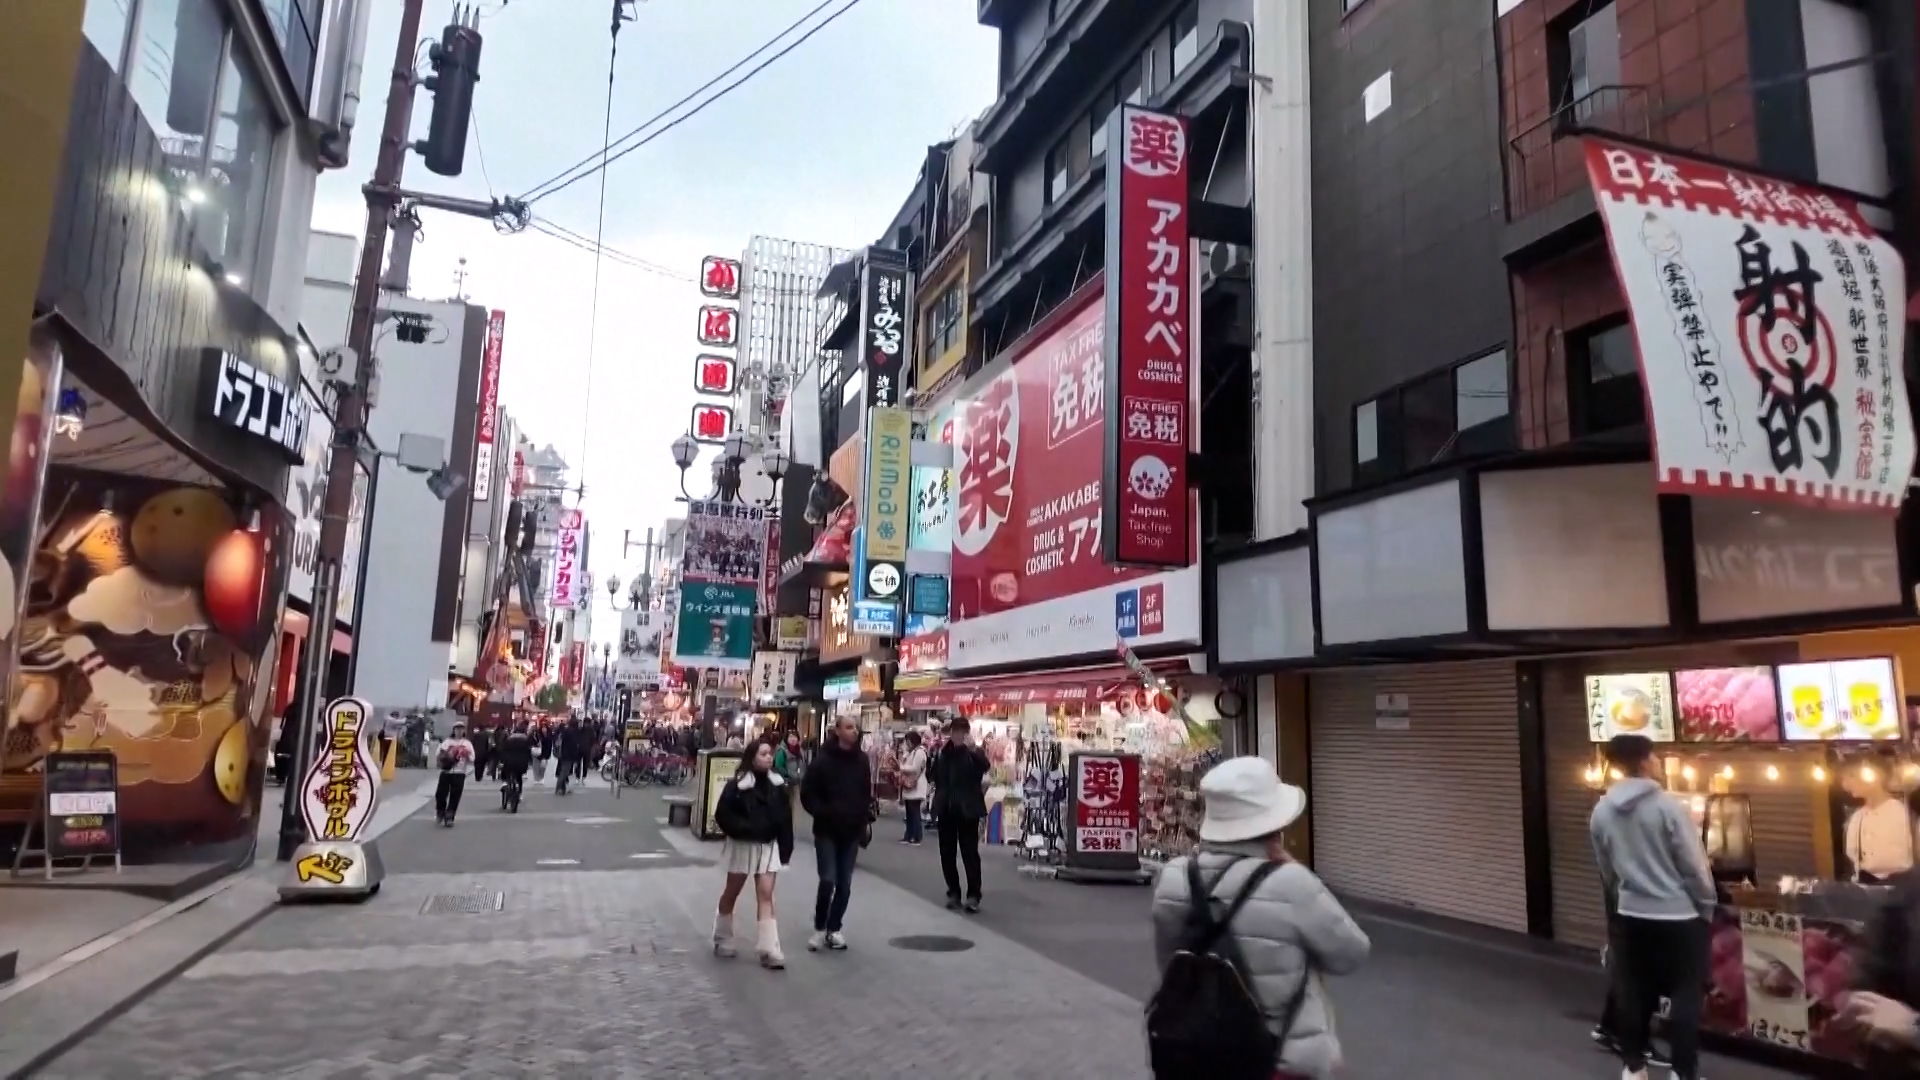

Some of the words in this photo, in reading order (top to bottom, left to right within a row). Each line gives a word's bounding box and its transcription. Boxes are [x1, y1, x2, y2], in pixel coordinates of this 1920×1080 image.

[1130, 115, 1178, 171] 薬
[1145, 199, 1183, 357] アカカベ
[1079, 321, 1105, 356] FRE
[1733, 223, 1842, 480] 射的
[1138, 369, 1183, 383] COSMETIC
[1147, 359, 1173, 371] DRUG
[1053, 351, 1105, 440] 免税
[1129, 401, 1149, 411] TAX
[1152, 403, 1178, 414] FREE
[1128, 412, 1179, 442] 免税
[959, 376, 1013, 538] 薬
[1044, 480, 1100, 521] AKAKABE
[1034, 528, 1056, 552] DRUG
[1058, 525, 1065, 544] &
[1128, 519, 1172, 534] Tax-free
[1136, 535, 1164, 548] Shop
[1026, 548, 1065, 576] COSMETIC
[1122, 600, 1131, 613] 1F
[1146, 593, 1156, 610] 2F
[324, 710, 358, 838] ドラゴンボウル
[1083, 761, 1120, 801] 薬
[1081, 837, 1122, 850] 免税
